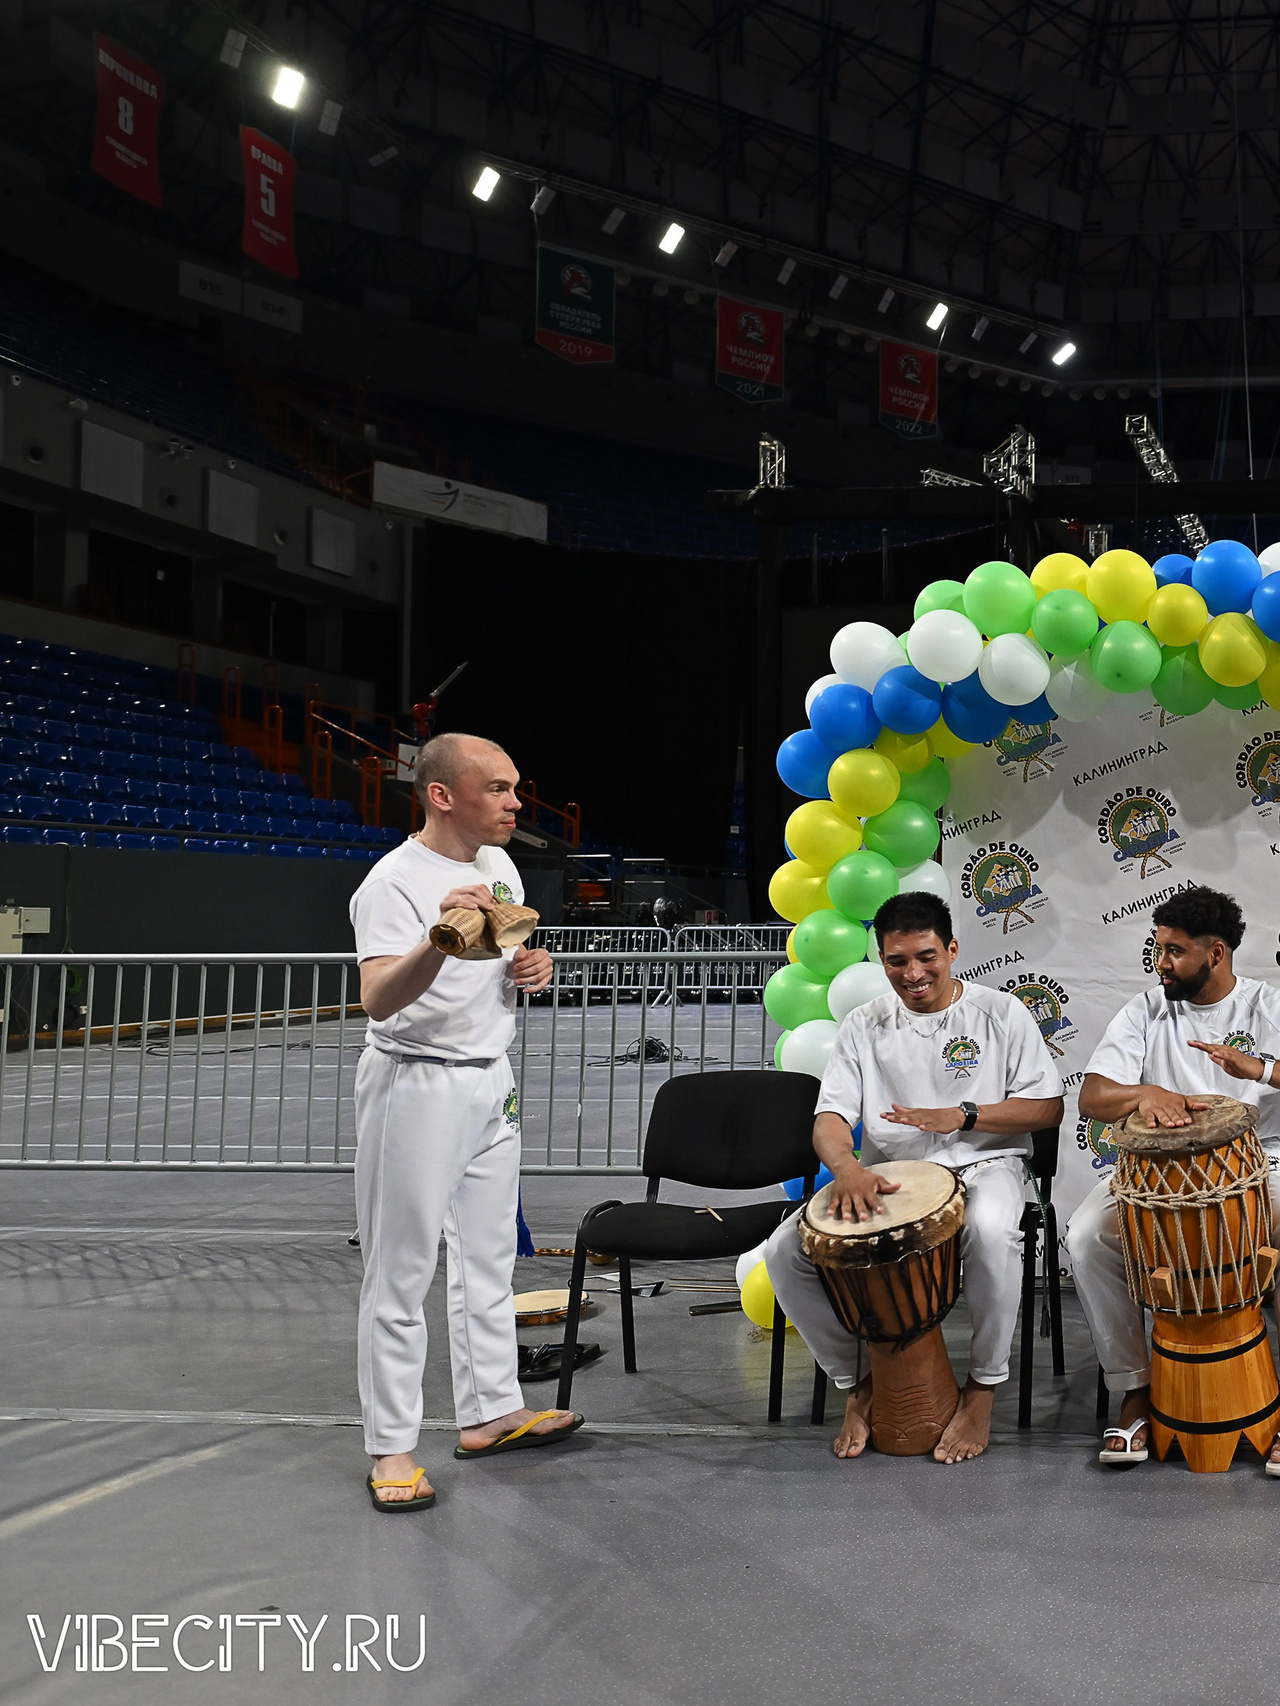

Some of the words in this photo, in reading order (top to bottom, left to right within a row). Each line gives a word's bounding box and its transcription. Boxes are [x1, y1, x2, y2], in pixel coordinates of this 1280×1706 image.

[118, 96, 133, 135] 8
[260, 174, 276, 217] 5
[550, 302, 602, 321] ОБЛАДАТЕЛЬ
[550, 310, 601, 329] СУПЕРКУБКА
[559, 320, 592, 334] РОССИИ
[559, 340, 592, 357] 2019
[727, 345, 774, 364] ЧЕМПИОН
[731, 356, 770, 372] РОССИИ
[736, 381, 765, 397] 2021
[888, 384, 929, 403] ЧЕМПИОН
[892, 397, 925, 411] РОССИИ
[896, 419, 922, 434] 2022
[1073, 740, 1168, 787] КАЛИНИНГРАД
[1236, 737, 1261, 788] CORDÃO
[1264, 731, 1280, 742] DE
[942, 810, 1002, 841] НИНГРАД
[1098, 793, 1124, 844] CORDÃO
[1126, 786, 1142, 798] DE
[1146, 788, 1176, 817] OURO
[1113, 829, 1180, 862] CAPOEIRA
[961, 848, 987, 899] CORDÃO
[989, 841, 1005, 852] DE
[1009, 843, 1039, 872] OURO
[976, 884, 1043, 917] CAPOEIRA
[956, 950, 1025, 981] ИНИНГРАД
[1018, 973, 1035, 983] DE
[1039, 975, 1069, 1004] OURO
[1041, 1016, 1073, 1037] EIRA
[942, 1037, 958, 1059] CORDÃO
[970, 1039, 981, 1054] OURO
